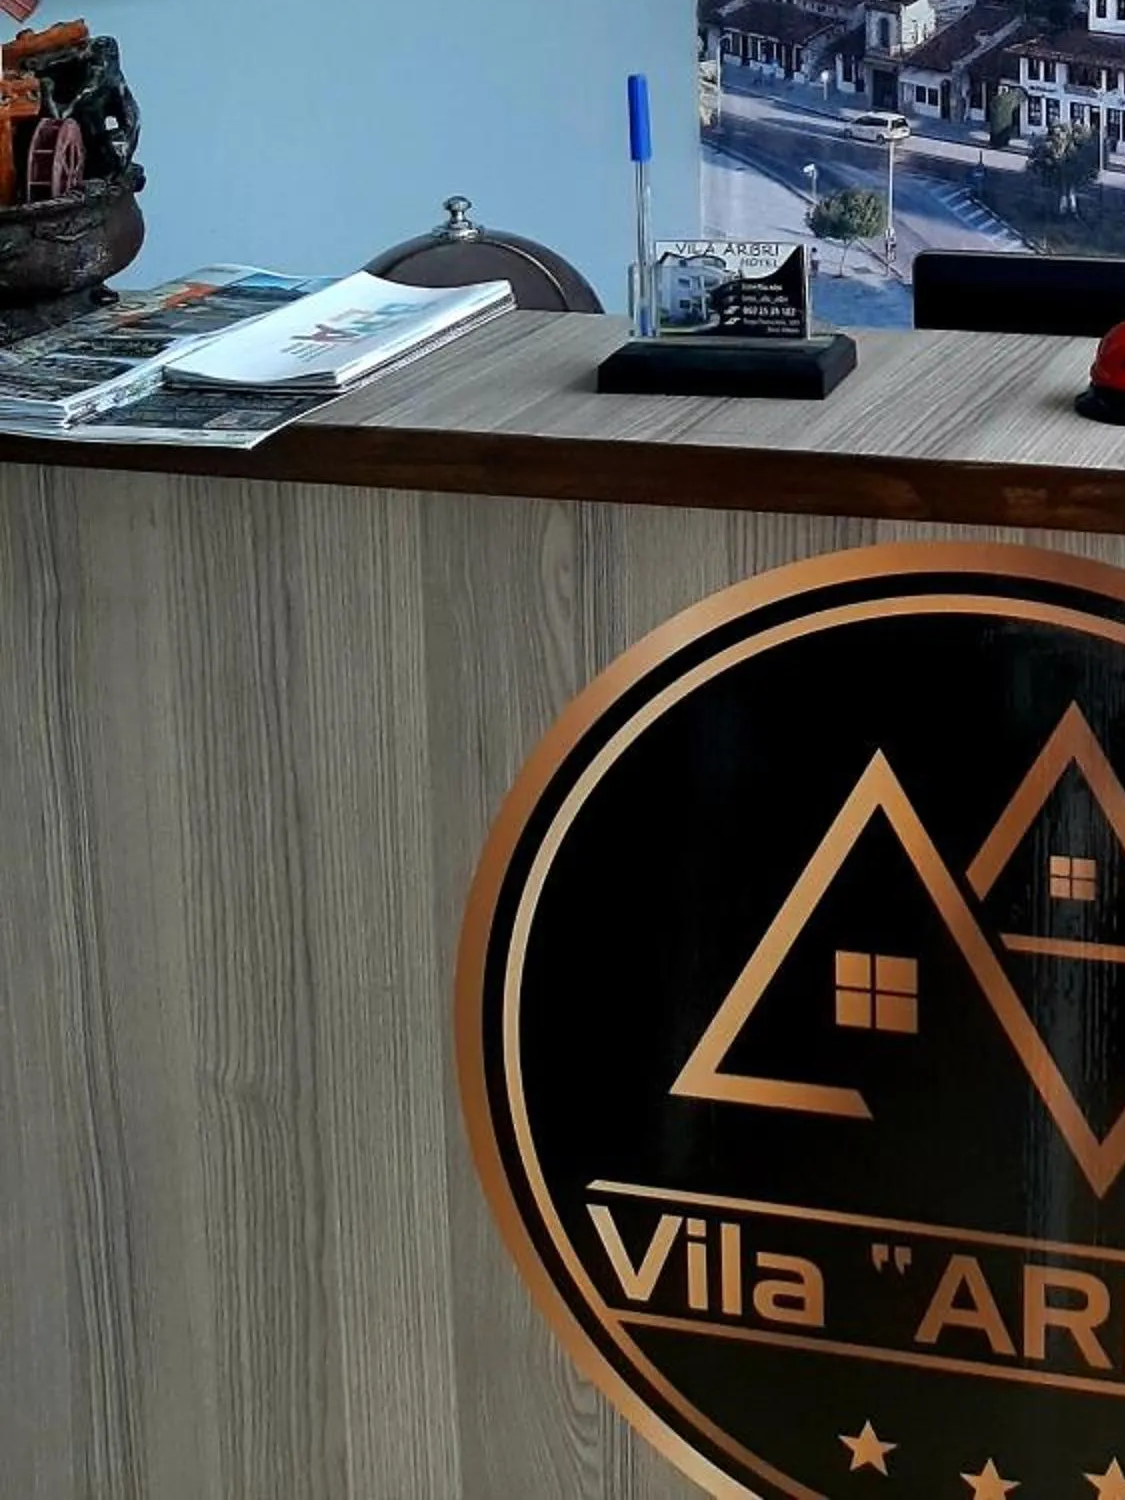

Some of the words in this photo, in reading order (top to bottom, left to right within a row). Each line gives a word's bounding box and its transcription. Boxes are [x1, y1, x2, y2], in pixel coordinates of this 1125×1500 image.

[675, 242, 715, 256] VILA
[723, 242, 779, 257] ARBRI
[584, 1202, 825, 1328] Vila
